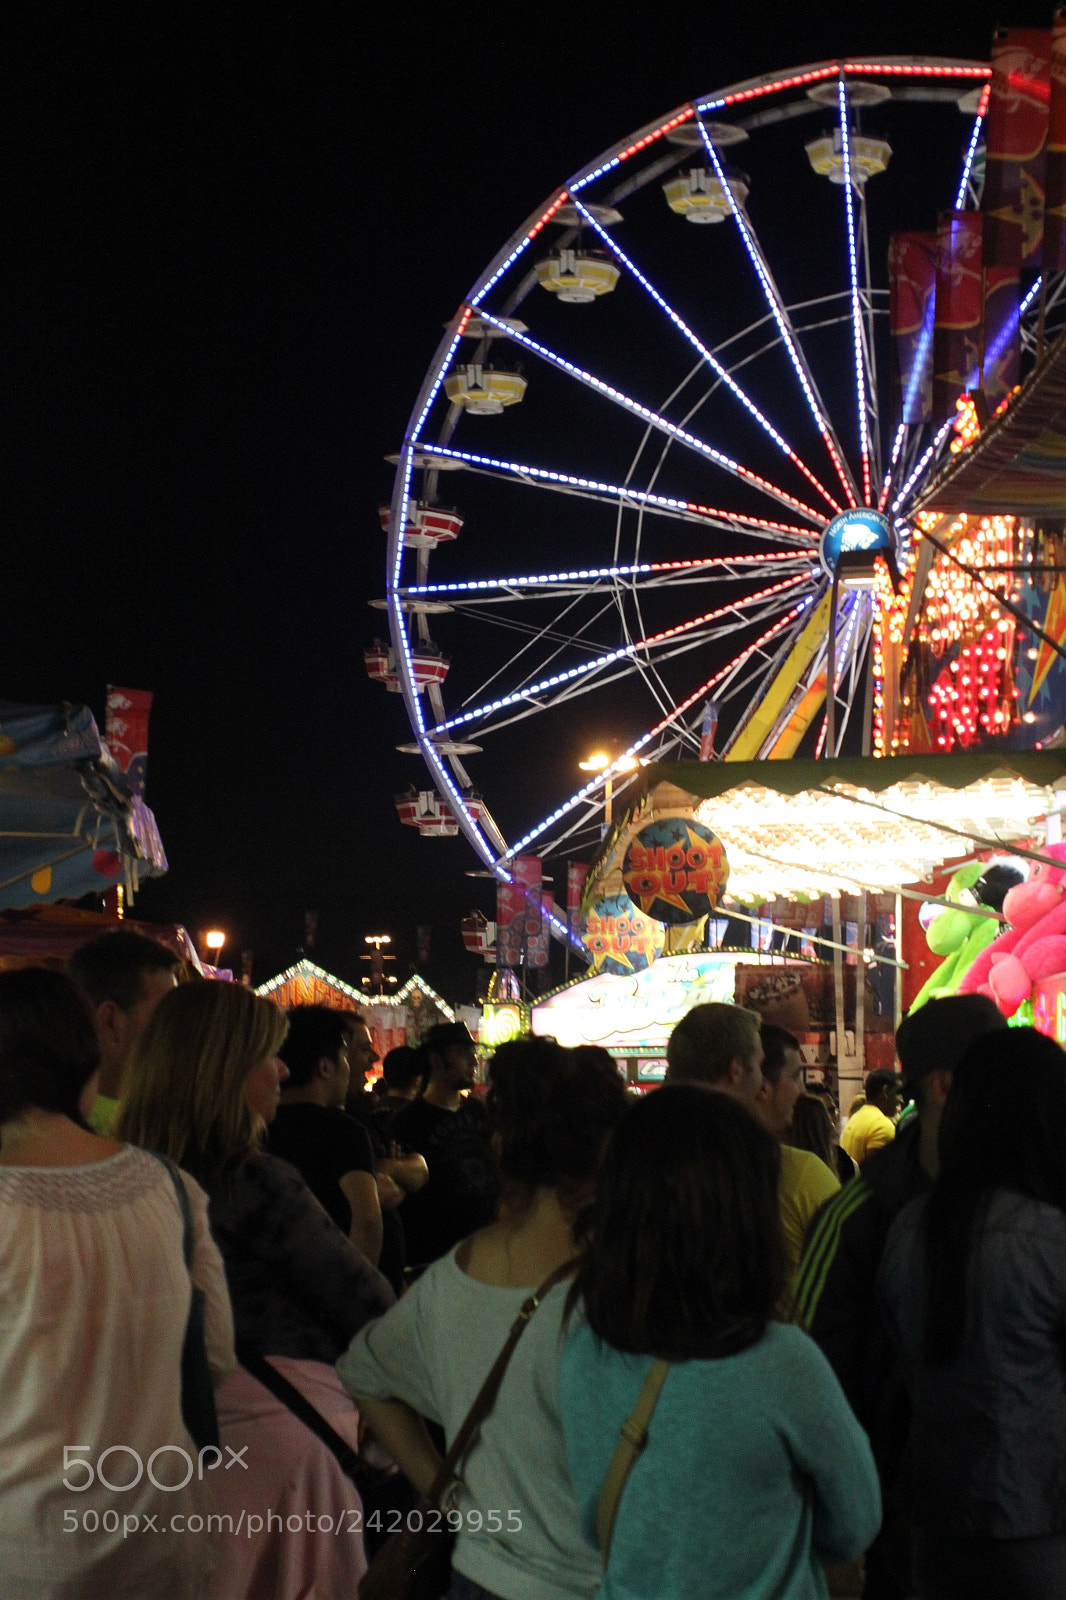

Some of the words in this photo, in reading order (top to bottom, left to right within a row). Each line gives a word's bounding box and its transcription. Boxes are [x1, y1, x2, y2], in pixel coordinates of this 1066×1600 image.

[848, 511, 880, 523] AMERICAN
[629, 846, 724, 871] SHOOT
[586, 915, 657, 934] SHOOT
